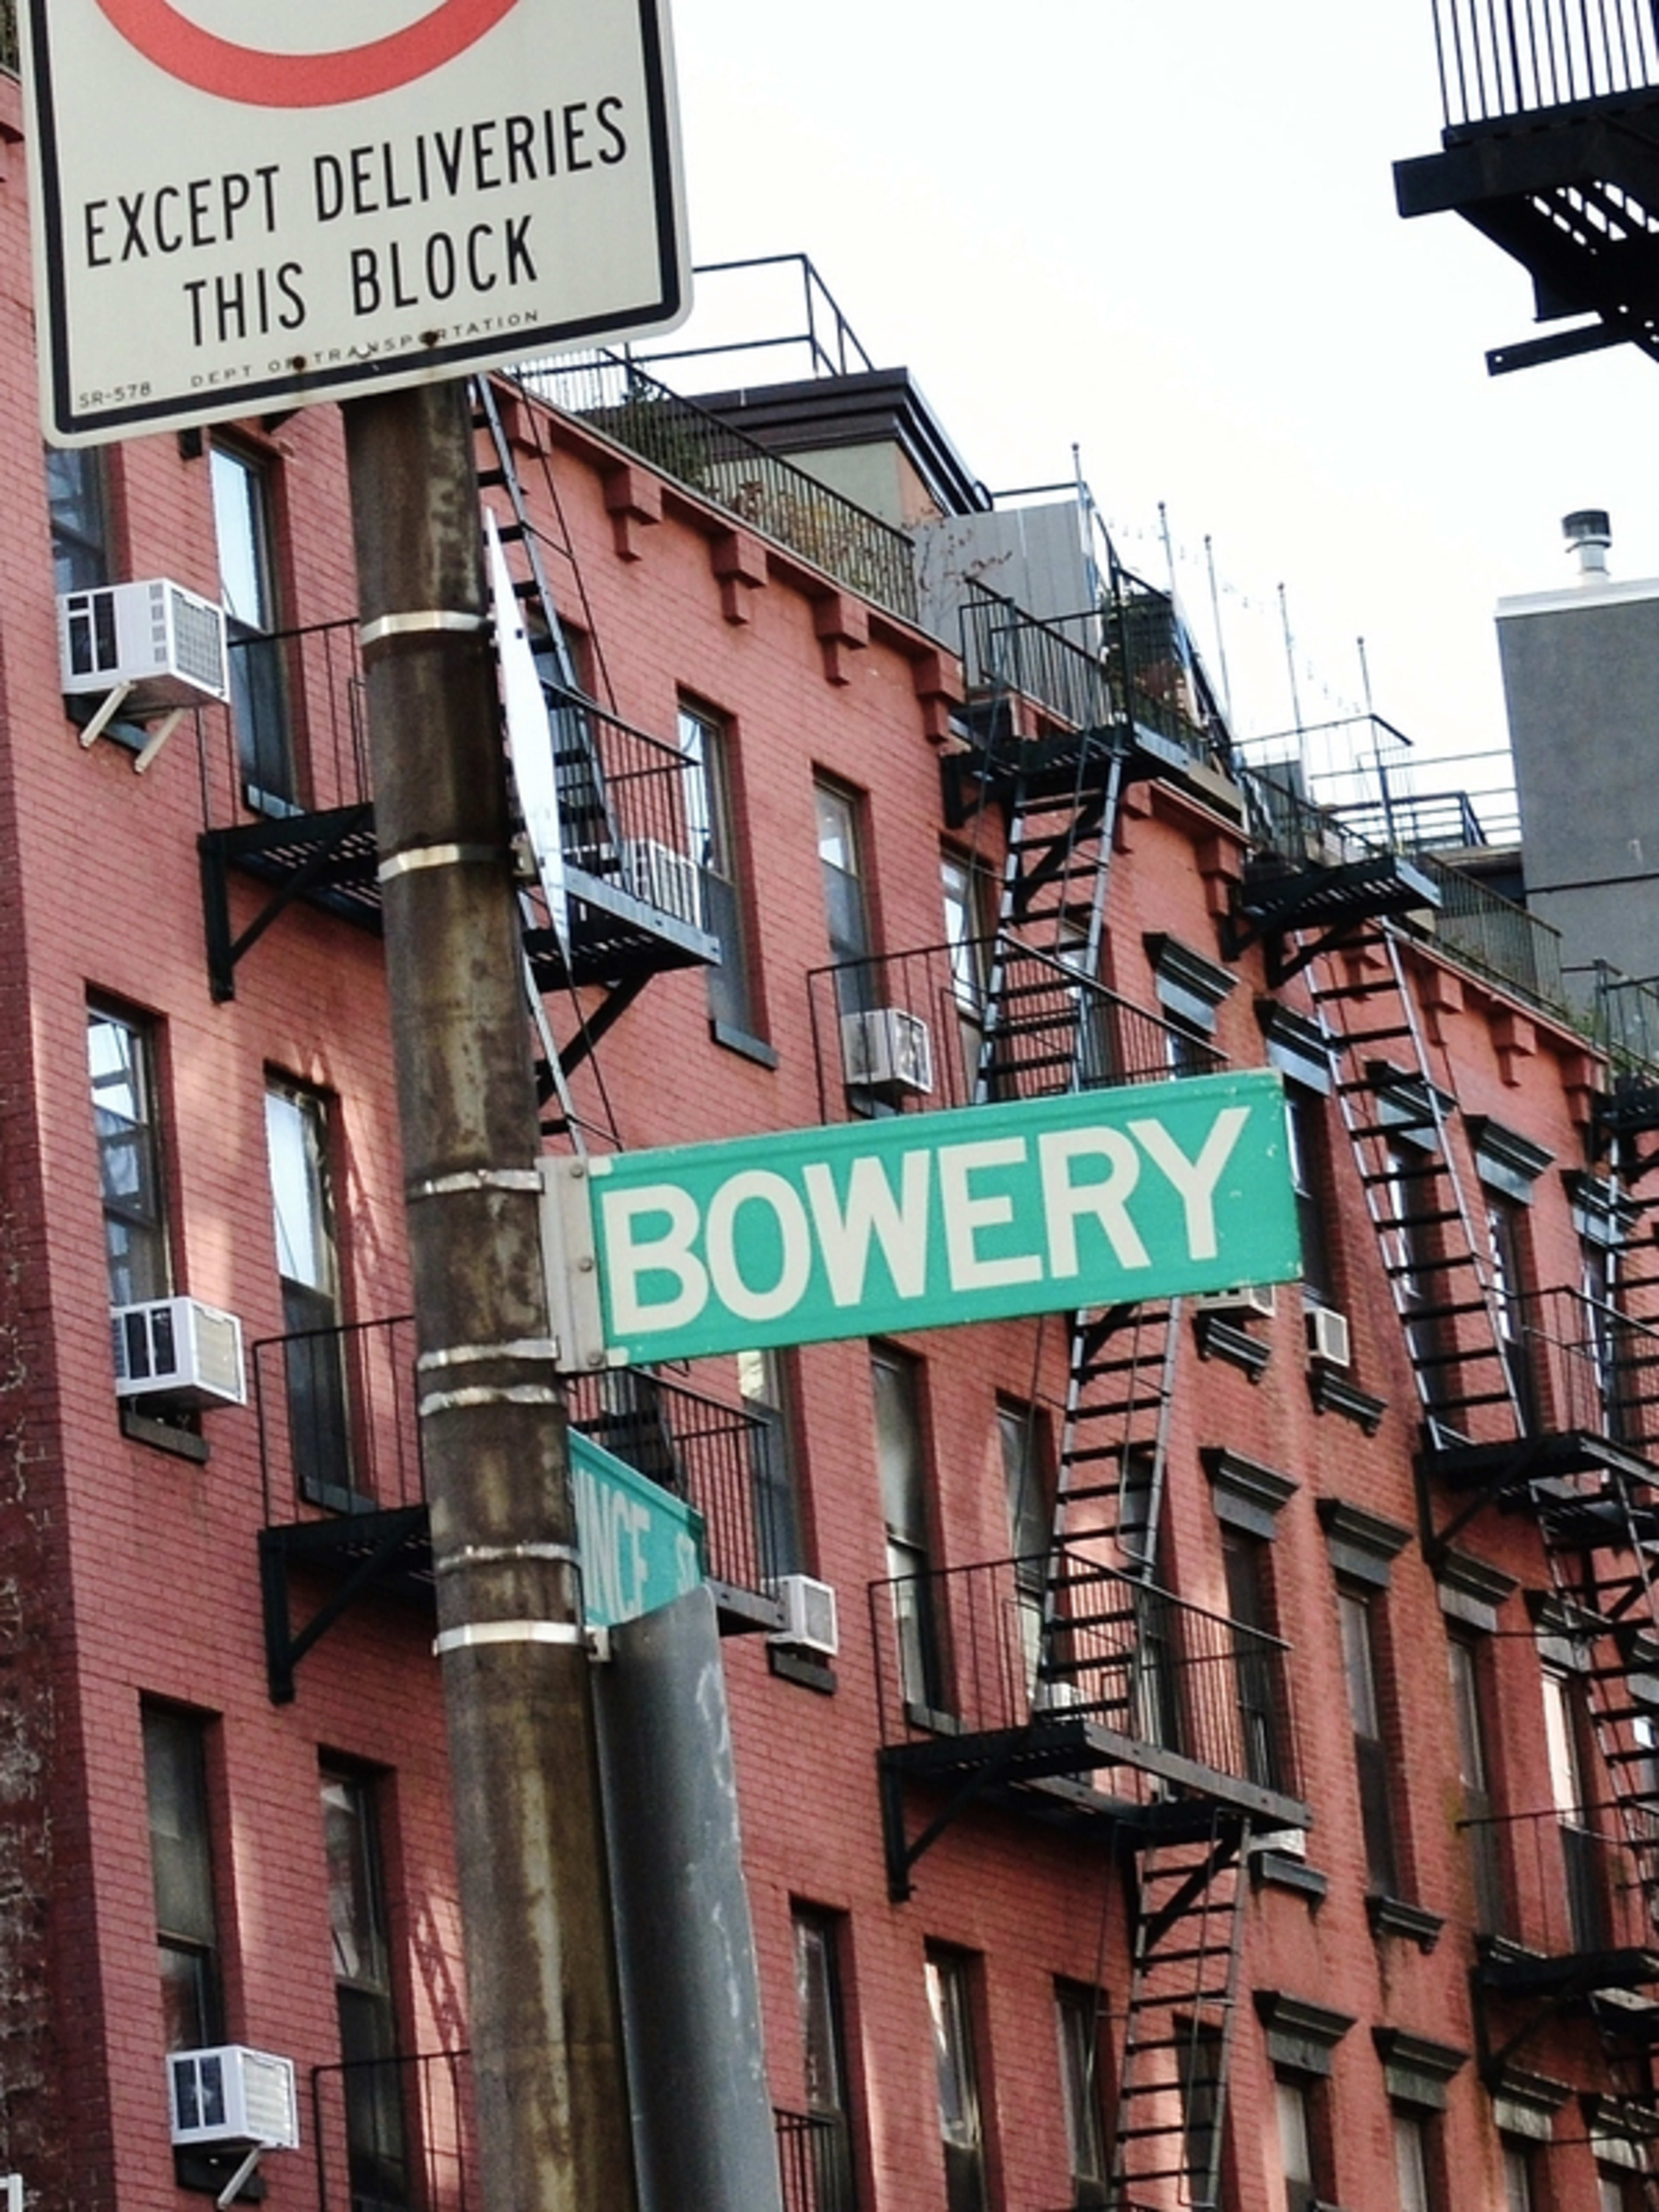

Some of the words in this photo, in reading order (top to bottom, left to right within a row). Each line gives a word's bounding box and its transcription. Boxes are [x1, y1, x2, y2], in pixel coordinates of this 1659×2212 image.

[85, 165, 280, 267] EXCEPT
[314, 96, 626, 222] DELIVERIES
[183, 262, 306, 346] THIS
[351, 215, 537, 316] BLOCK
[79, 382, 152, 408] SR-578
[191, 365, 252, 388] DEPT
[602, 1108, 1251, 1337] BOWERY
